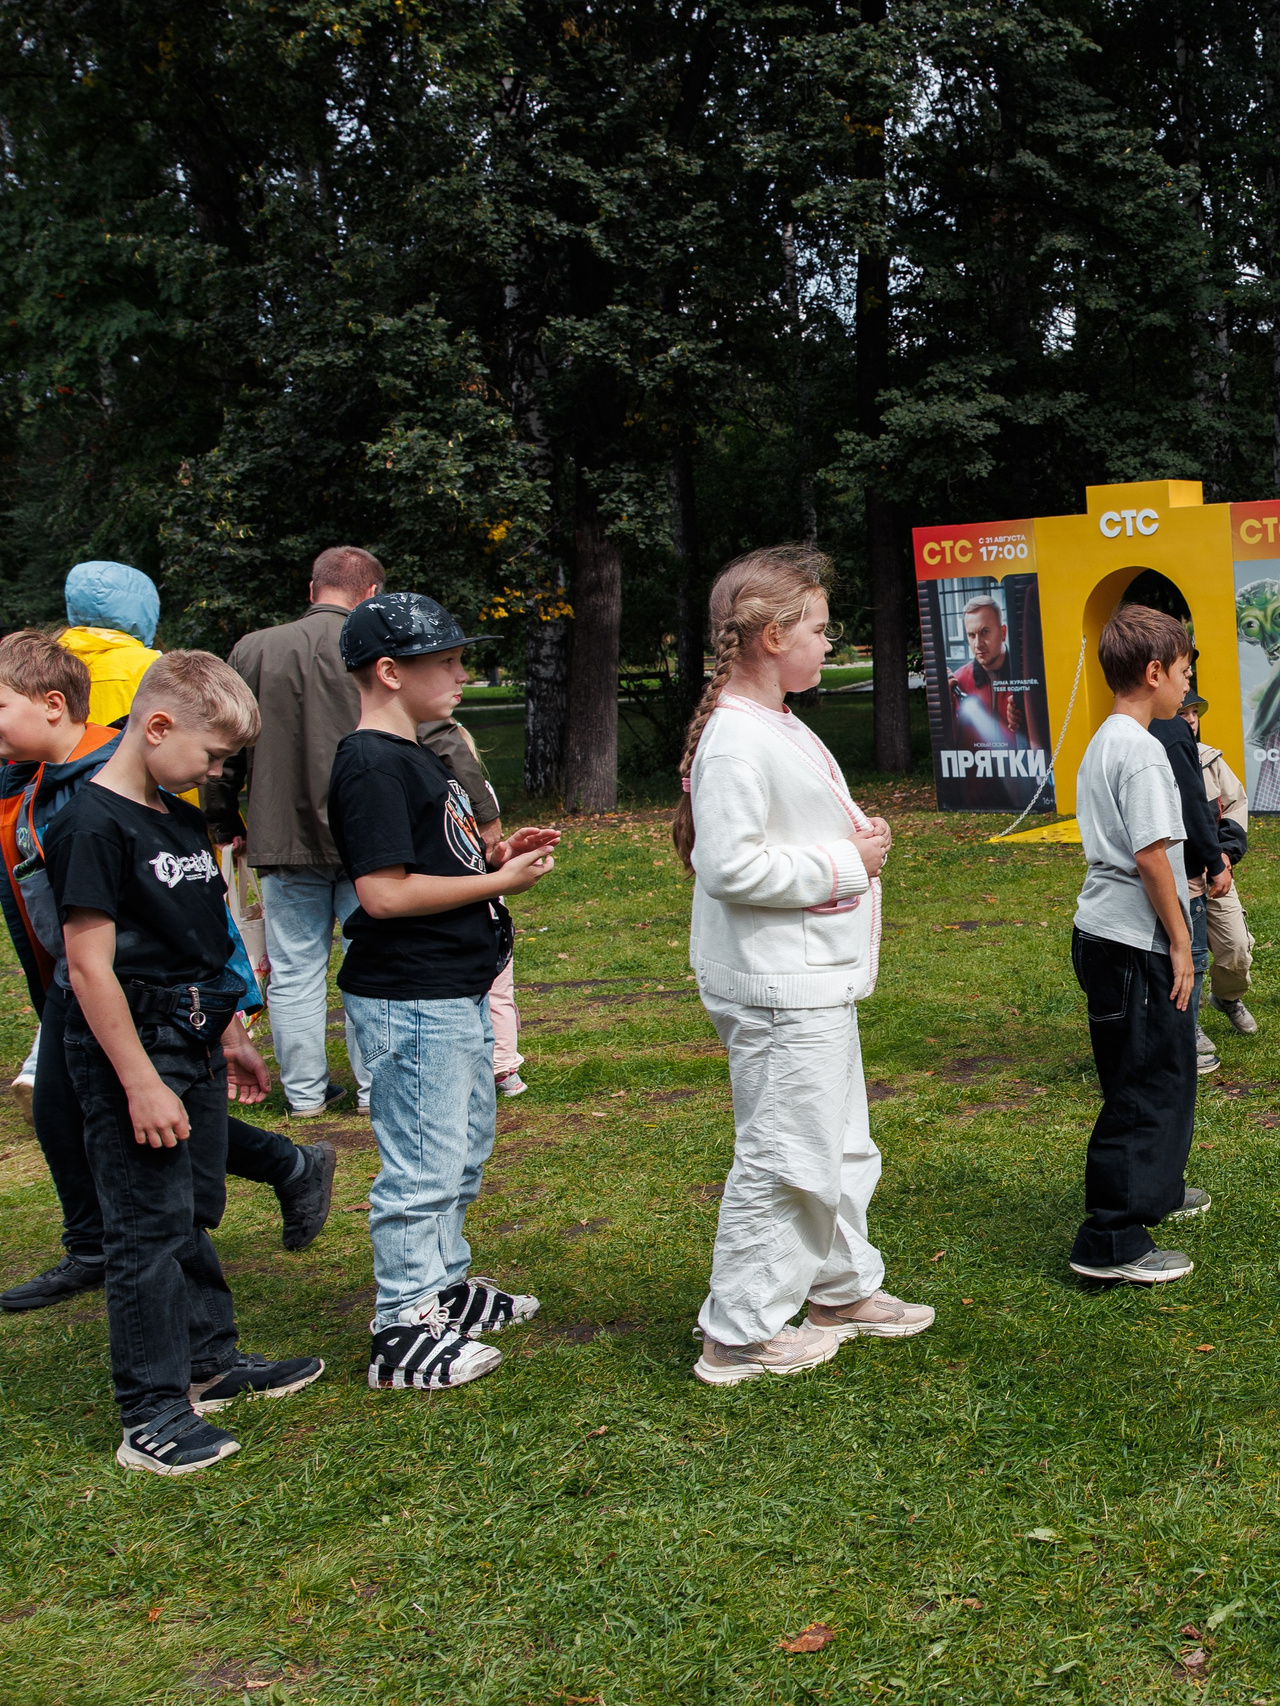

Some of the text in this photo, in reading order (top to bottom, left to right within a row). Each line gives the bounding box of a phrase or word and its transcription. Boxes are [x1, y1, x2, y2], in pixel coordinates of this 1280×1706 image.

[1099, 508, 1160, 539] СТС
[994, 534, 1026, 543] АВГУСТА
[923, 539, 973, 565] СТС
[979, 543, 1028, 562] 17:00
[940, 749, 1047, 778] ПРЯТКИ
